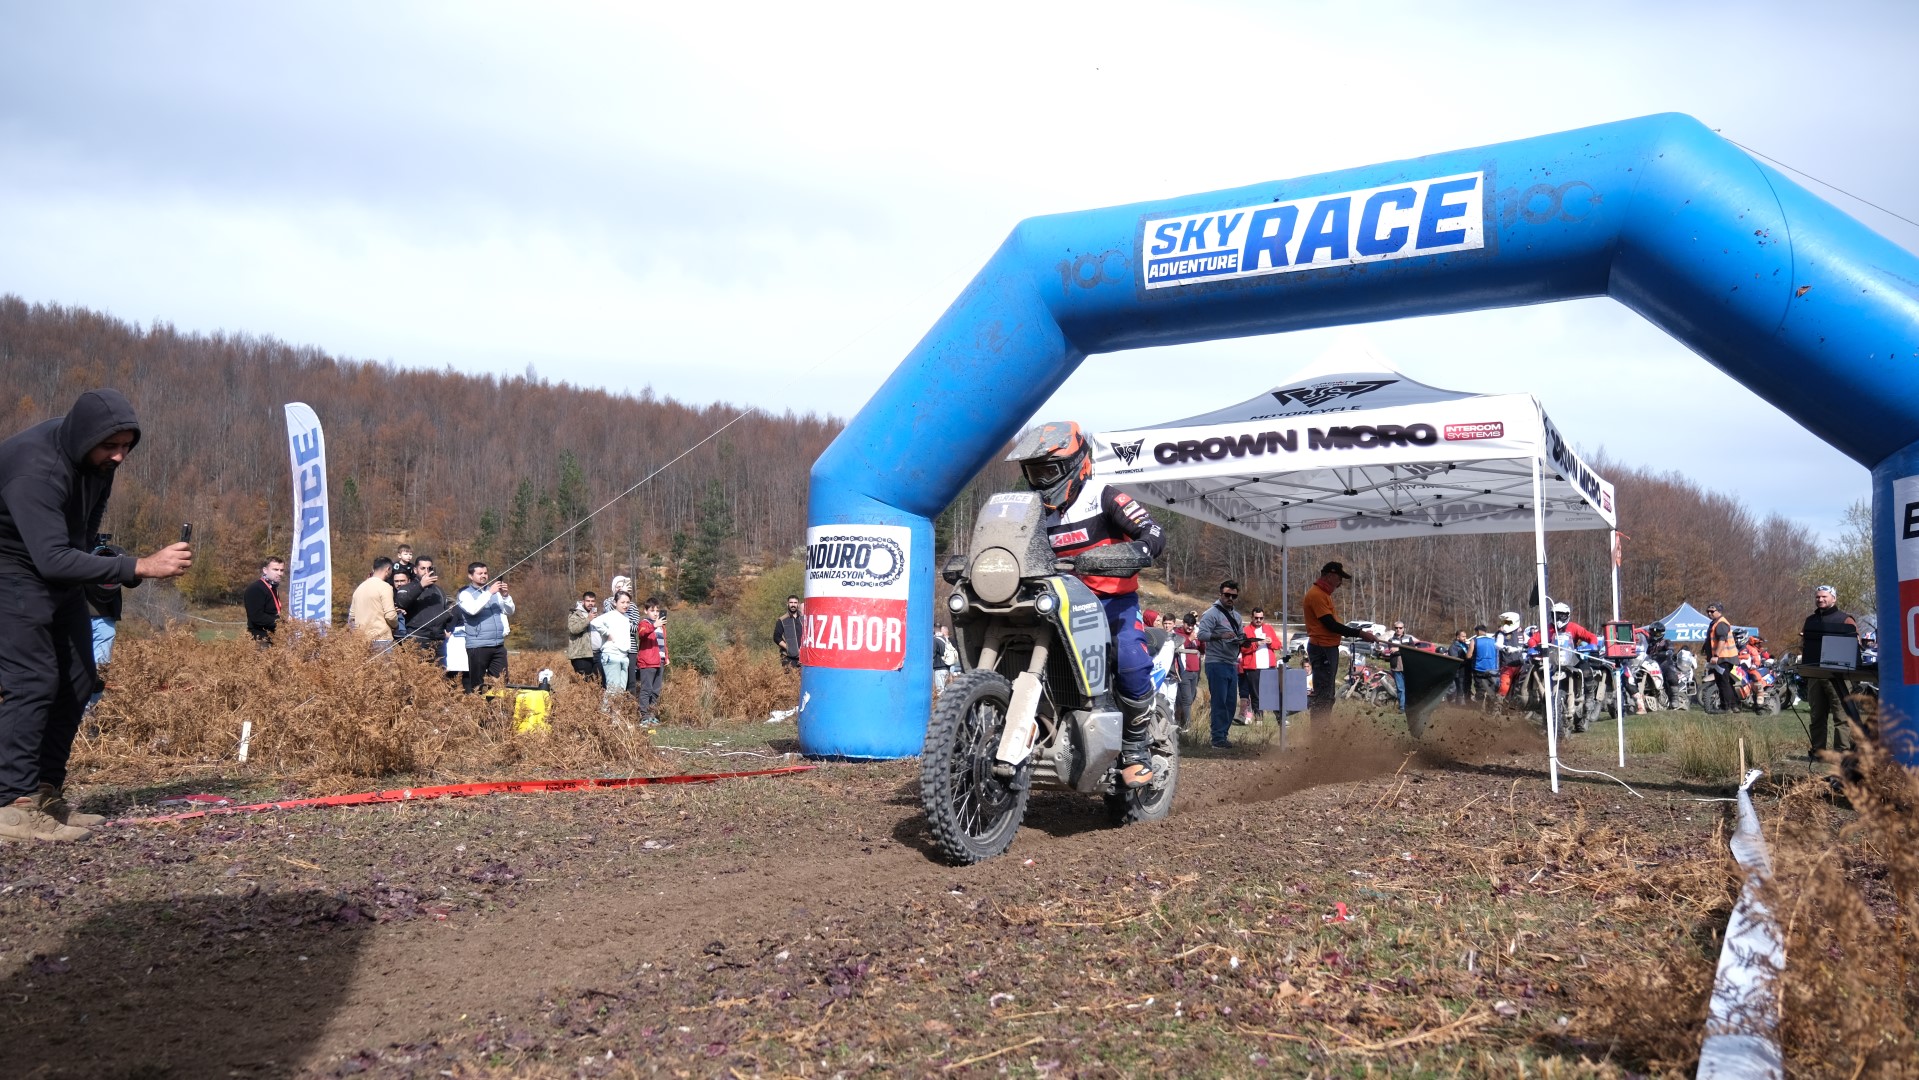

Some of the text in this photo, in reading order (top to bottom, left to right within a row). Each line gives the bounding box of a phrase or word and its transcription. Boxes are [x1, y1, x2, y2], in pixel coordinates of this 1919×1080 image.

[1150, 177, 1478, 271] SKY RACE
[1149, 254, 1238, 279] ADVENTURE
[1250, 405, 1362, 420] MOTORCYCLE
[1446, 423, 1501, 432] INTERCOM
[1448, 430, 1501, 440] SYSTEMS
[1154, 423, 1438, 465] CROWN MICRO
[1579, 463, 1601, 508] MICRO
[998, 504, 1009, 518] 1
